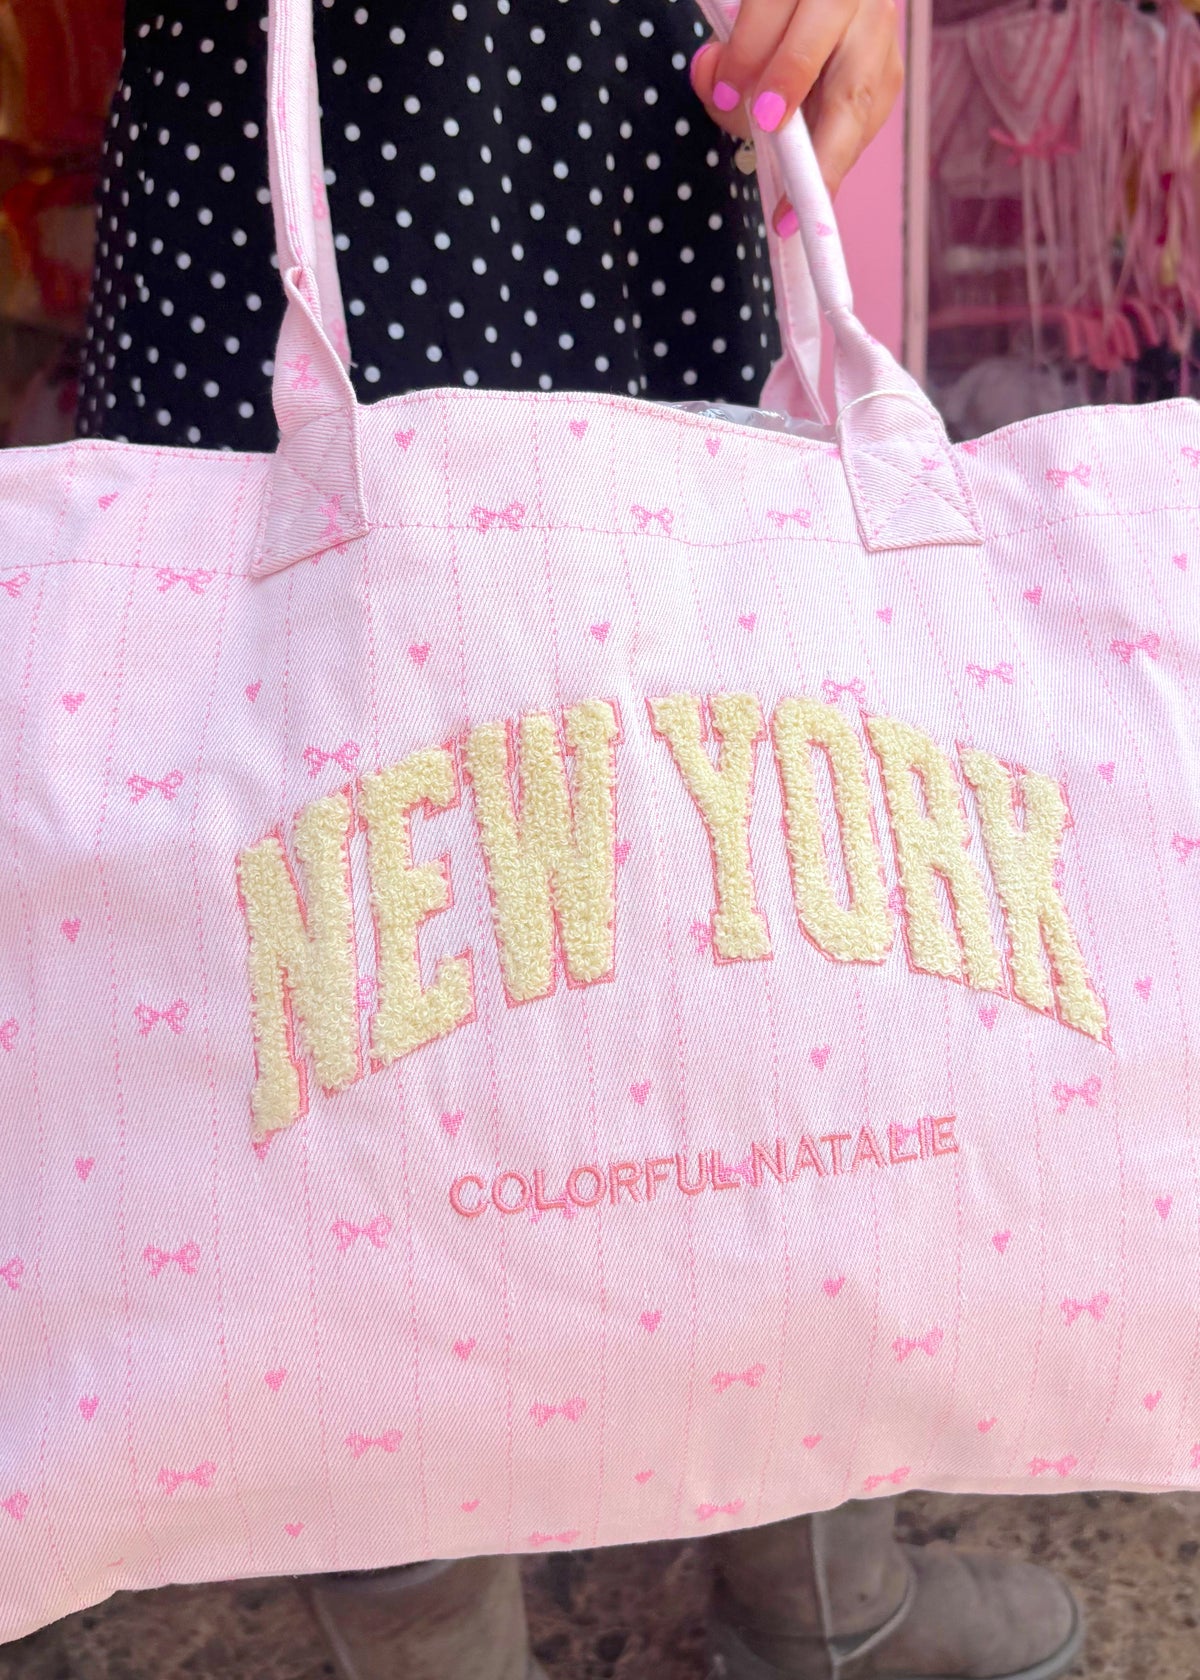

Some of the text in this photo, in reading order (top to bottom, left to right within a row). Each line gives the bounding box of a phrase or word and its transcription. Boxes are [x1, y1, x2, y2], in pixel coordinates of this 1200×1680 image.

[236, 690, 1114, 1146] NEW YORK
[449, 1115, 959, 1218] COLORFUL NATALIE
